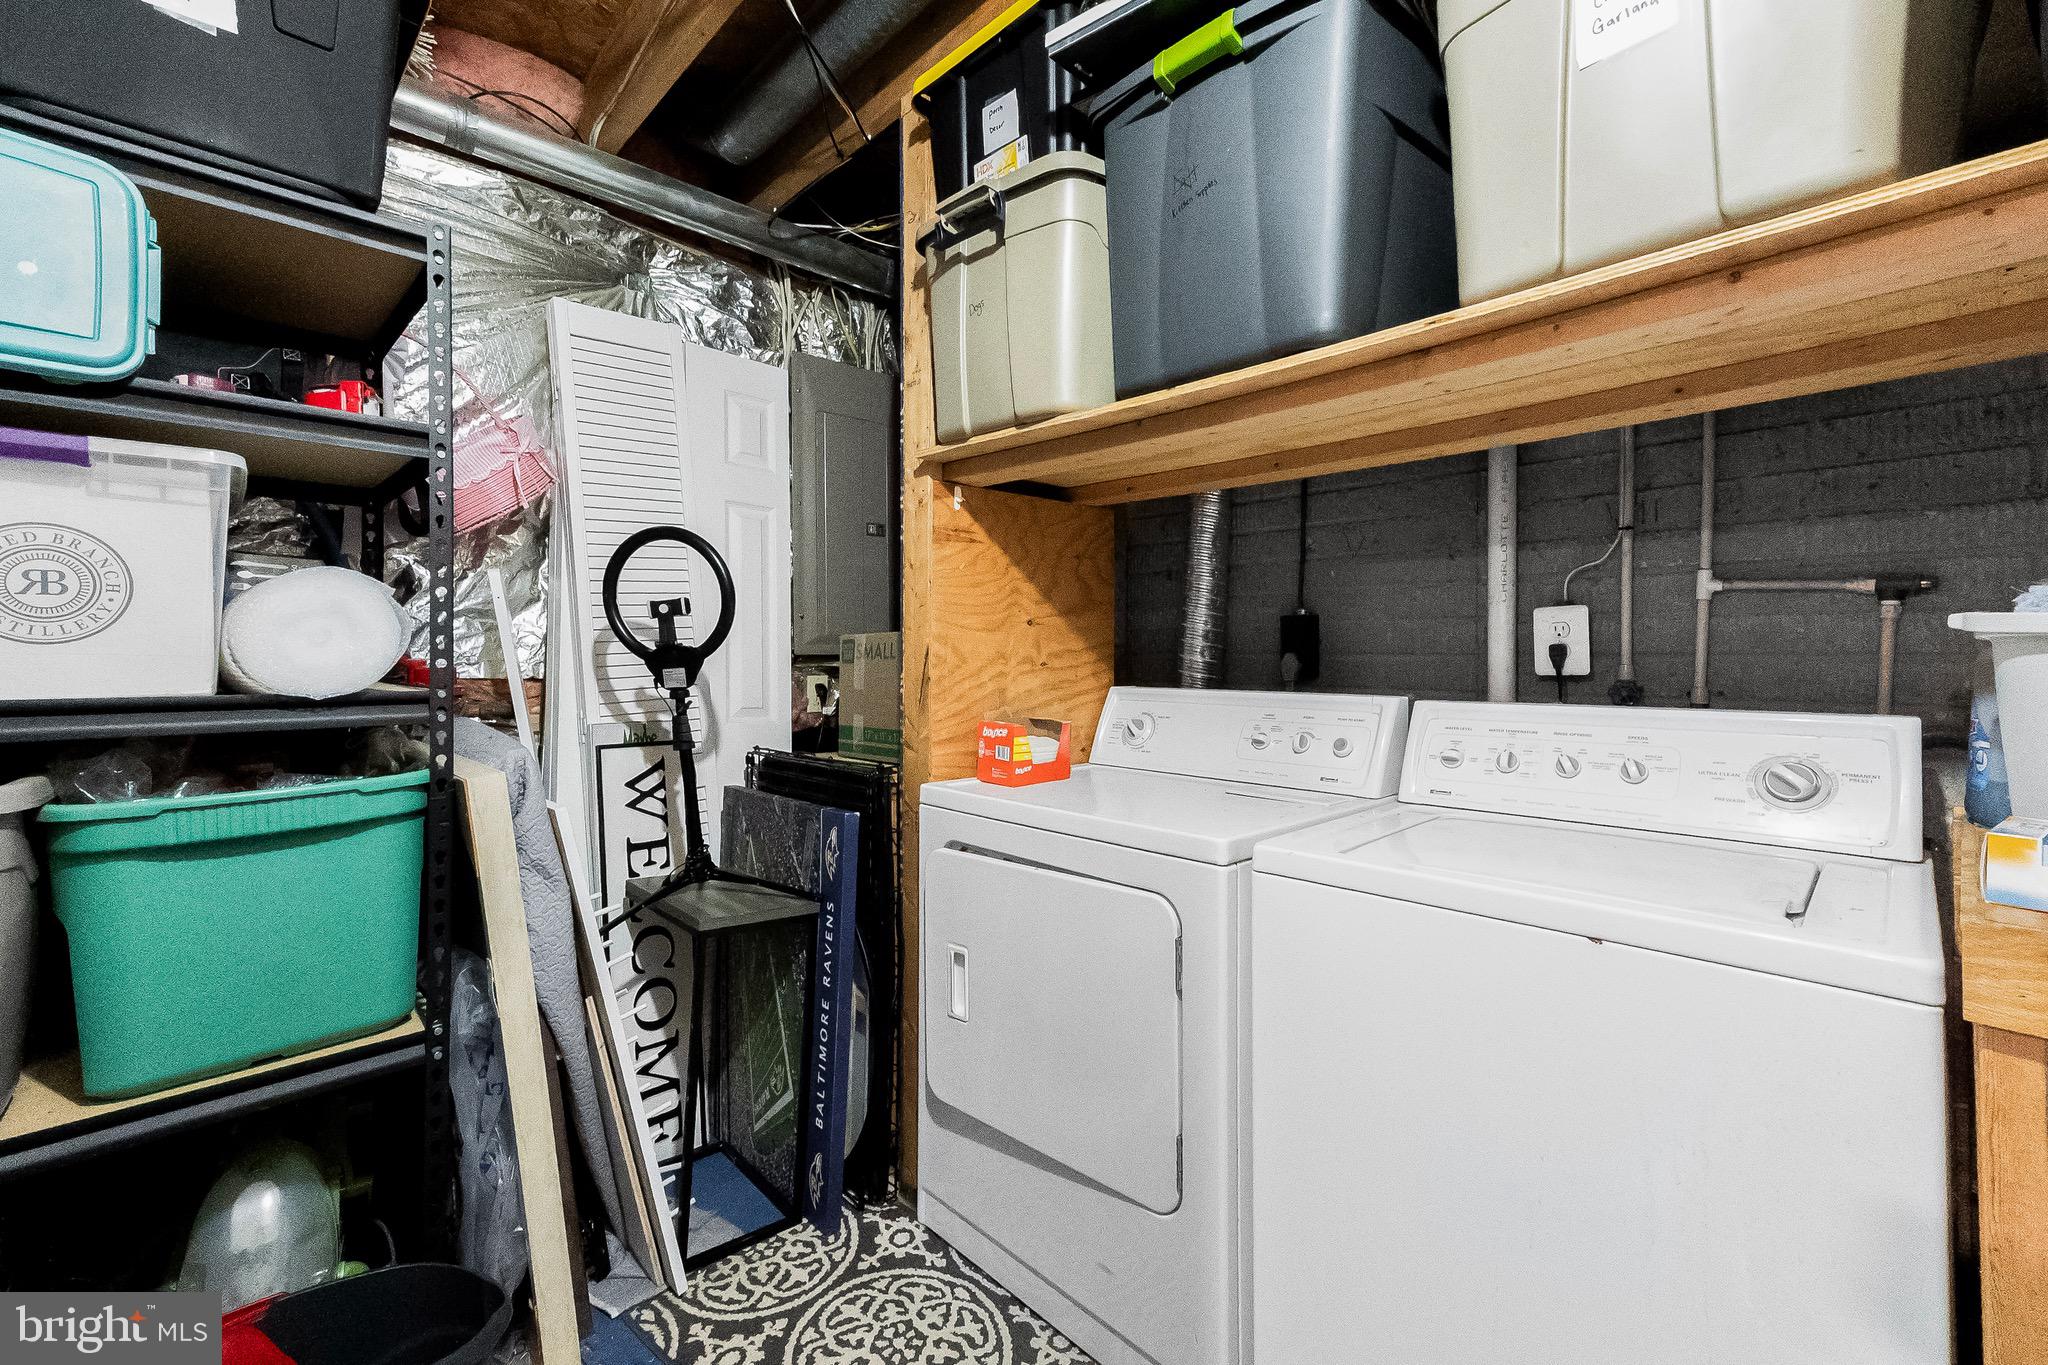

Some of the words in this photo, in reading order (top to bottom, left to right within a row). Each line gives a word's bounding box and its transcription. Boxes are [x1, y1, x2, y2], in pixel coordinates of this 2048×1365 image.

[1592, 0, 1659, 34] Garlan
[976, 161, 993, 177] HDX
[968, 299, 985, 317] Dogs
[51, 532, 121, 594] BRANCH
[854, 641, 897, 660] SMALL
[982, 726, 1009, 738] bounce
[1841, 772, 1881, 780] PERMANENT
[822, 900, 834, 988] RAVENS
[815, 998, 830, 1130] BALTIMORE
